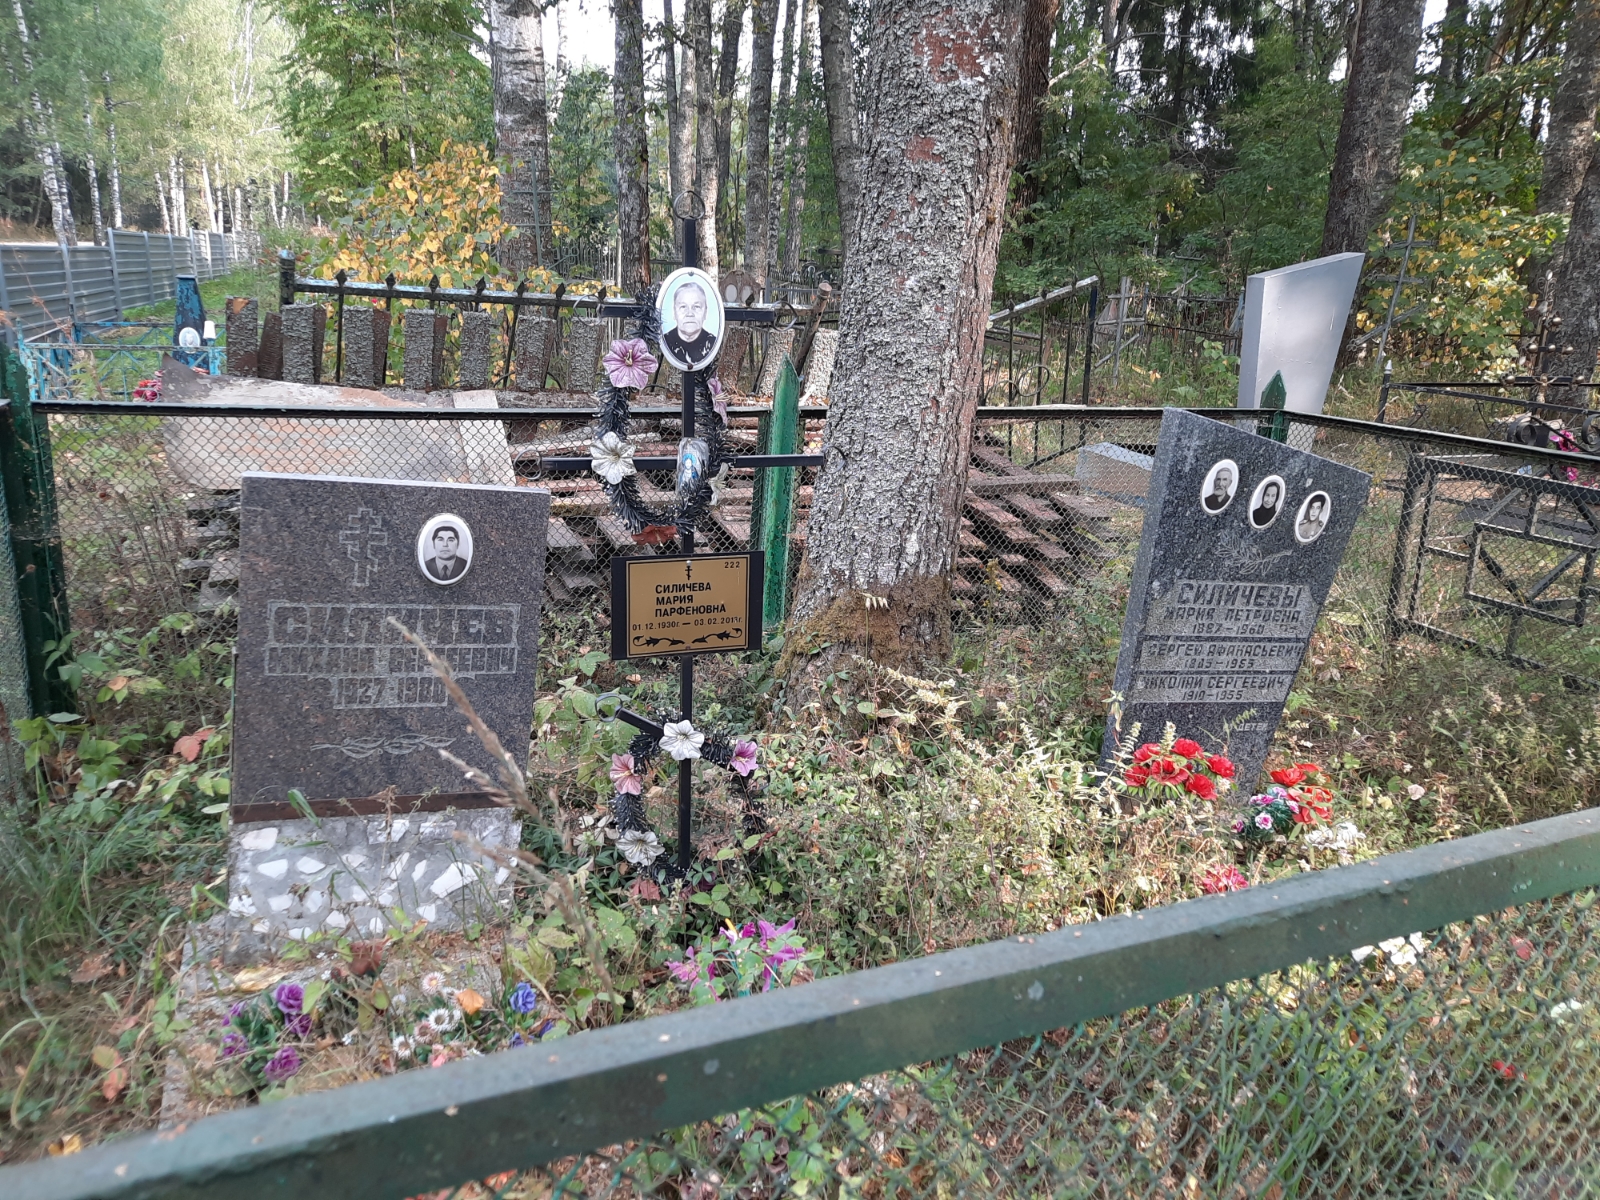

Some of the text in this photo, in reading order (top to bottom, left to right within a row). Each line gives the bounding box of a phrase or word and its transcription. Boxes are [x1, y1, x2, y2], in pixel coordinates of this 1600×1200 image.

[724, 561, 741, 569] 222
[655, 582, 712, 594] СИЛИЧЕВА
[655, 594, 693, 605] МАРИЯ
[1178, 583, 1302, 608] СИЛИЧЕВЫ
[655, 604, 726, 618] ПАРФЕНОВНА
[1163, 606, 1301, 623] МАРИЯ ПЕТРОВНА
[271, 605, 512, 645] СИЛИЧЕВ
[1206, 644, 1304, 658] АФАНАСЬЕВИЧ
[1206, 676, 1285, 690] СЕРГЕЕВИЧ
